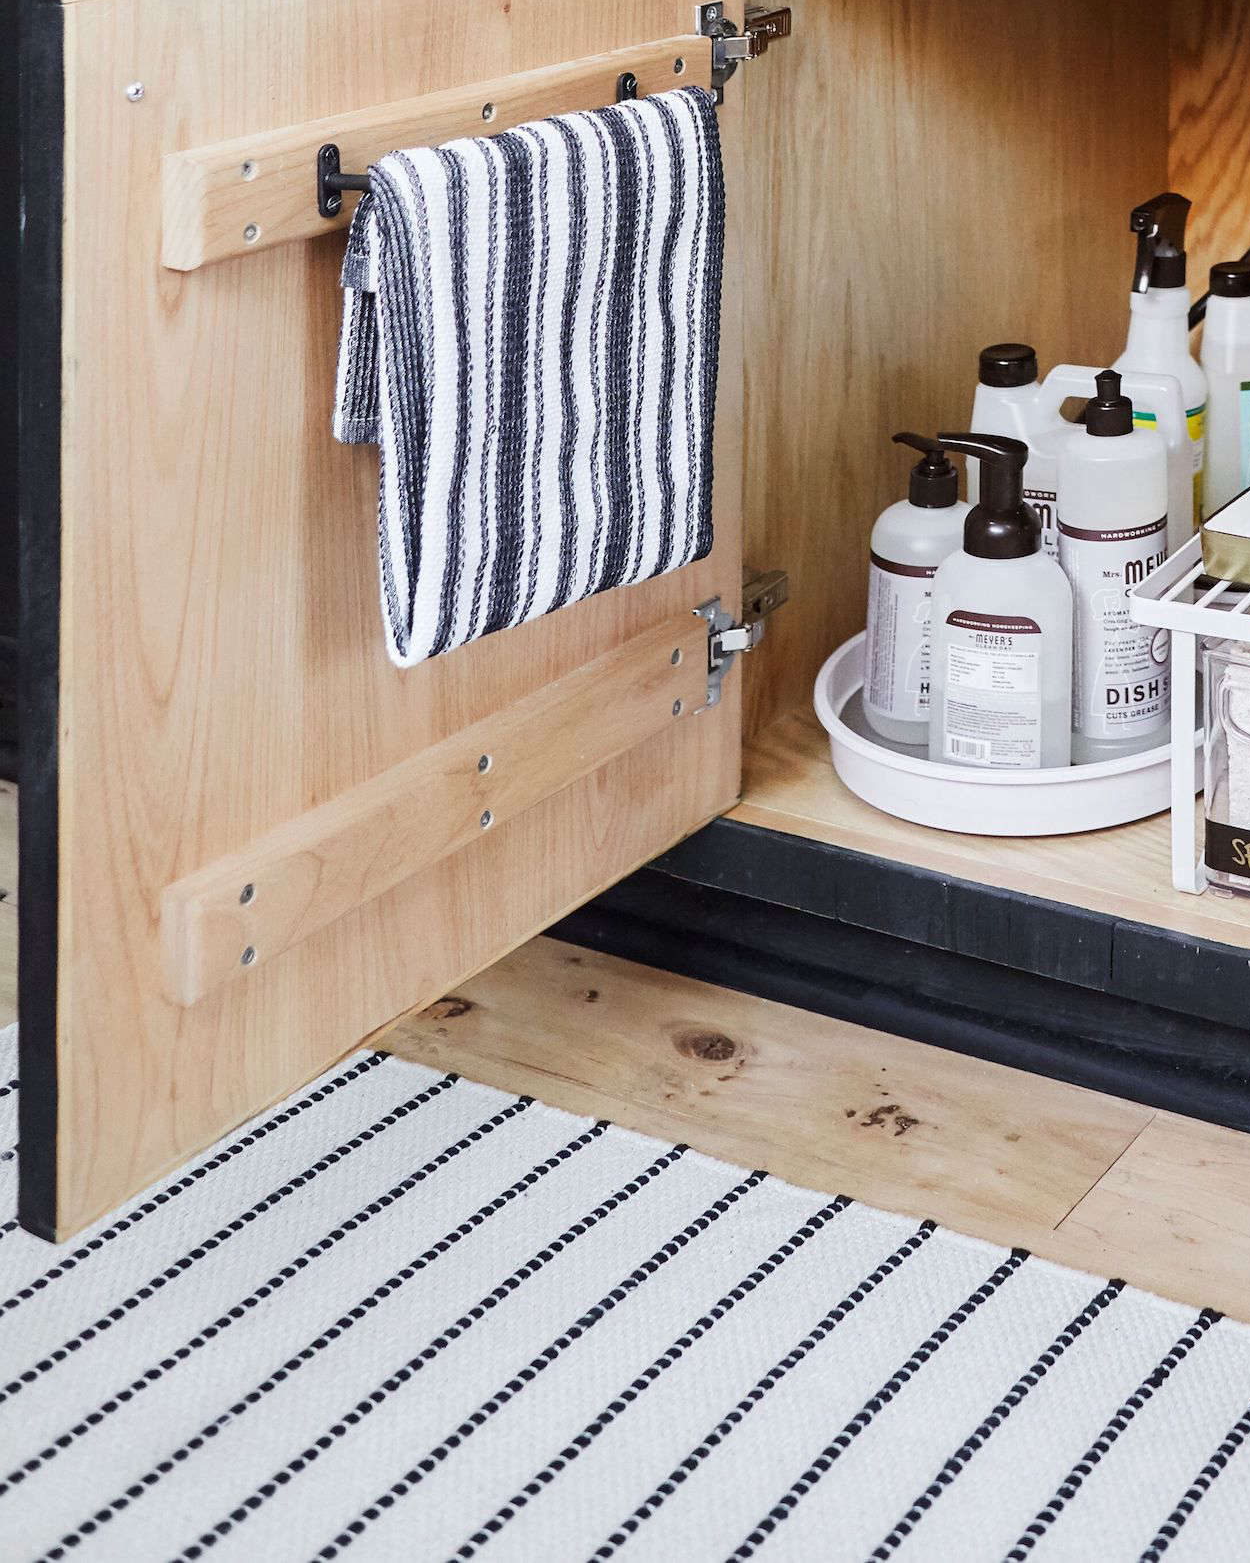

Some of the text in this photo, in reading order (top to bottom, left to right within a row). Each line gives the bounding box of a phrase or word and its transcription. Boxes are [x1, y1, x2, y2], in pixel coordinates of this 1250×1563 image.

[1100, 525, 1157, 540] HARDWORKING
[1103, 571, 1122, 579] Mrs.
[975, 633, 1013, 647] MEYER'S
[1106, 679, 1159, 705] DISH
[1106, 703, 1160, 720] CUTS GREASE
